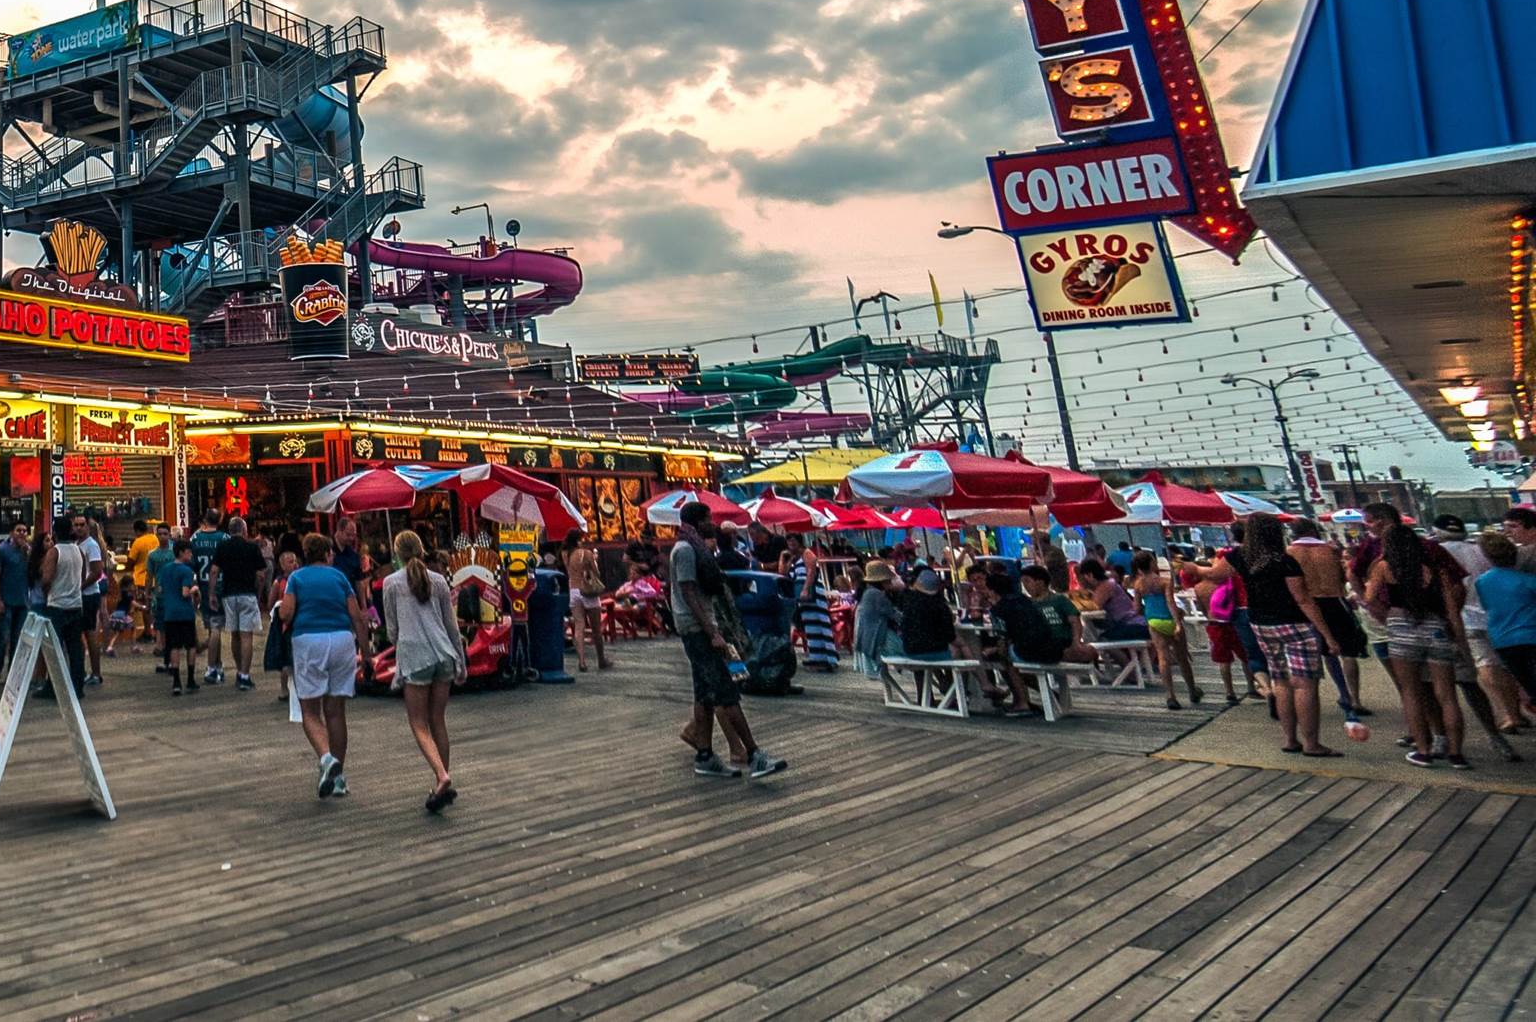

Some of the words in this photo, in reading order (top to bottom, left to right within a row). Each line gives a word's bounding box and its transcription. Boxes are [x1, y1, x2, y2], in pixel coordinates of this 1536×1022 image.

[1003, 153, 1181, 216] CORNER
[1029, 233, 1155, 274] GYROS
[21, 273, 55, 291] The
[57, 279, 126, 301] Original
[1042, 310, 1086, 322] DINING
[1089, 306, 1127, 318] ROOM
[1131, 302, 1172, 315] INSIDE
[50, 306, 191, 355] POTATOES
[5, 409, 47, 440] CAKE
[89, 409, 113, 419] FRESH
[133, 413, 148, 422] CUT
[384, 447, 422, 461] CUTLETS
[438, 450, 469, 463] SHRIMP
[484, 453, 508, 466] WINGS
